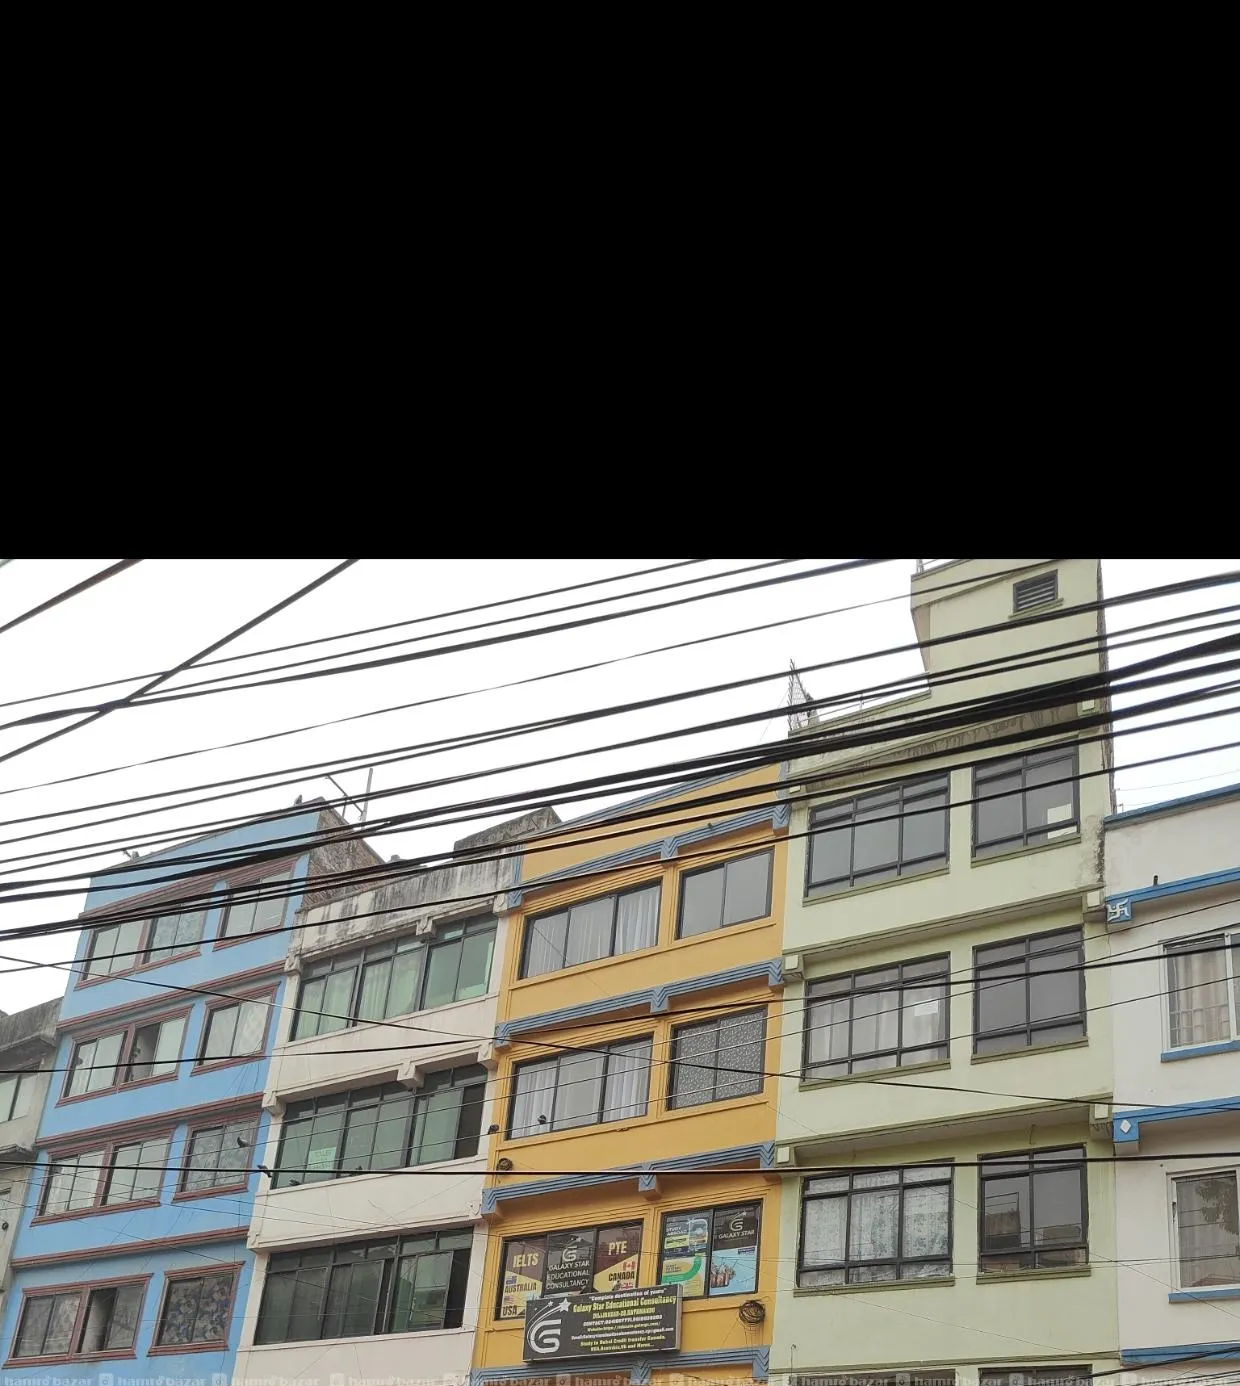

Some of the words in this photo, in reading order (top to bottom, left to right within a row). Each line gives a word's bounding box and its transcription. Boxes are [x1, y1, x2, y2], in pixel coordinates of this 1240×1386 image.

[608, 1241, 628, 1256] PTE
[513, 1252, 539, 1268] IELTS
[548, 1263, 574, 1272] GALAXY
[574, 1261, 590, 1269] STAR
[547, 1271, 590, 1281] EDUCATIONAL
[608, 1271, 635, 1282] CANADA
[505, 1282, 537, 1293] AUSTRALIA
[546, 1279, 589, 1290] CONSULTANCY
[502, 1305, 518, 1316] USA
[573, 1303, 593, 1313] Galaxy
[593, 1302, 605, 1310] Star
[605, 1298, 639, 1309] Educational
